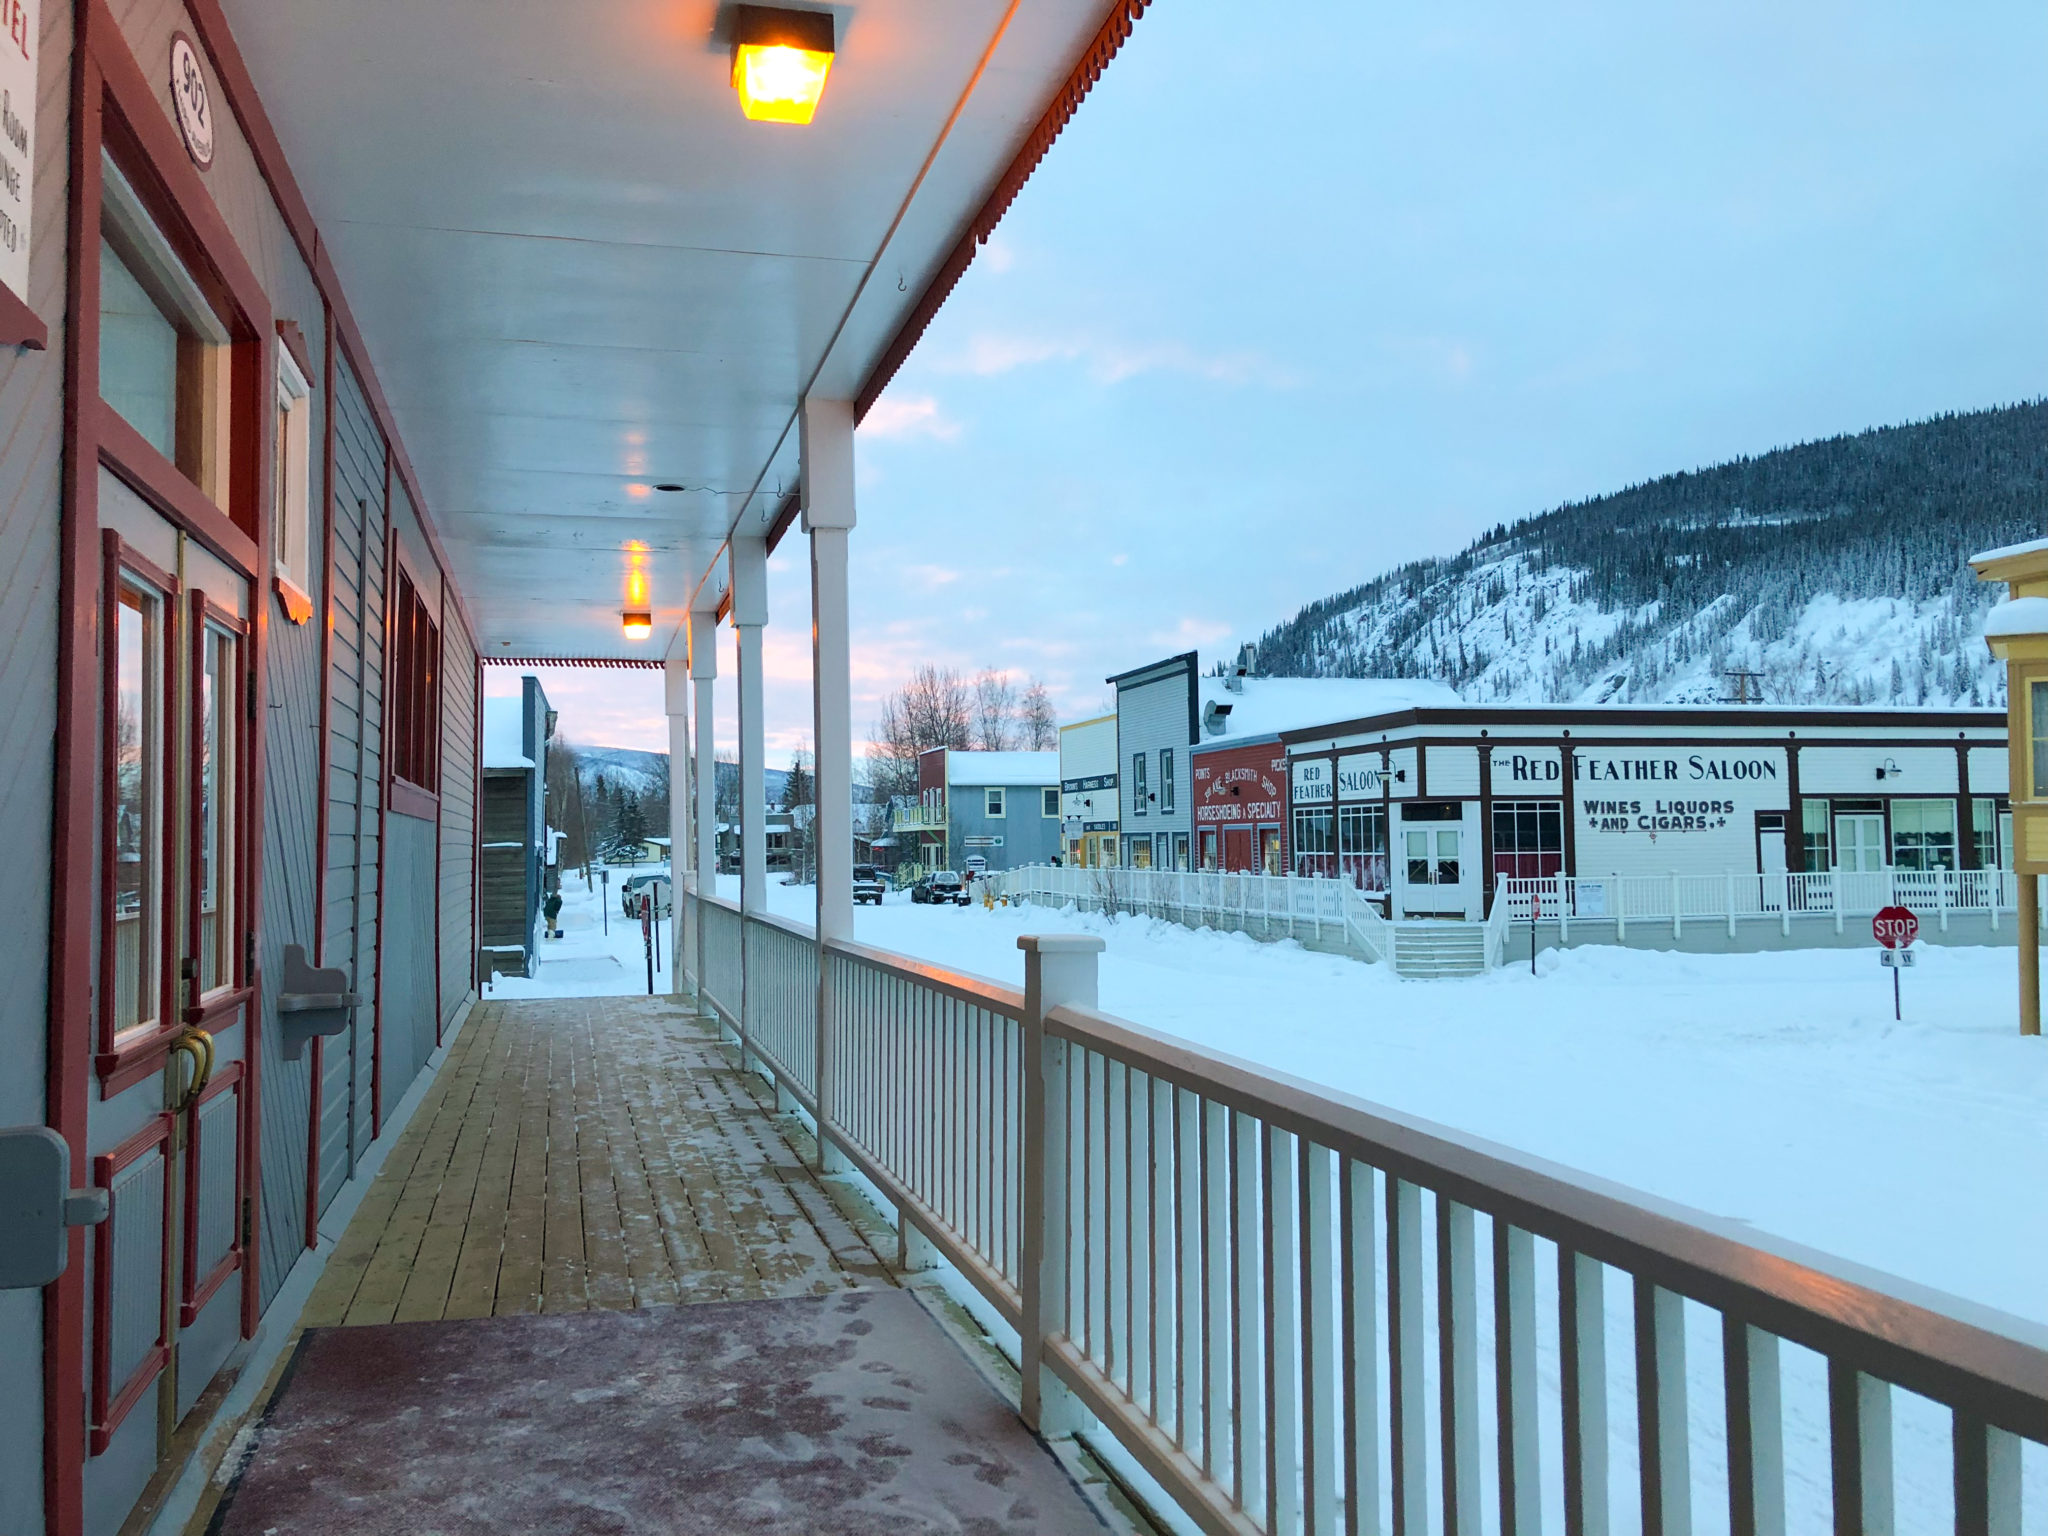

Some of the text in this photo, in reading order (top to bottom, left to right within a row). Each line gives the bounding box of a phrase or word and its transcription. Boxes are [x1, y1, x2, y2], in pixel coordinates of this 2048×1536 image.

[183, 51, 205, 129] 902
[1225, 768, 1258, 784] BLACKSMITH
[1303, 767, 1320, 781] RED
[1513, 755, 1560, 781] RED
[1573, 755, 1678, 780] FEATHER
[1688, 755, 1776, 780] SALOON
[1294, 783, 1333, 799] FEATHER
[1197, 803, 1241, 821] HORSESHOEING
[1247, 801, 1281, 819] SPECIALTY
[1583, 800, 1735, 815] WINES LIQUORS
[1601, 817, 1629, 830] AND
[1875, 919, 1917, 937] STOP
